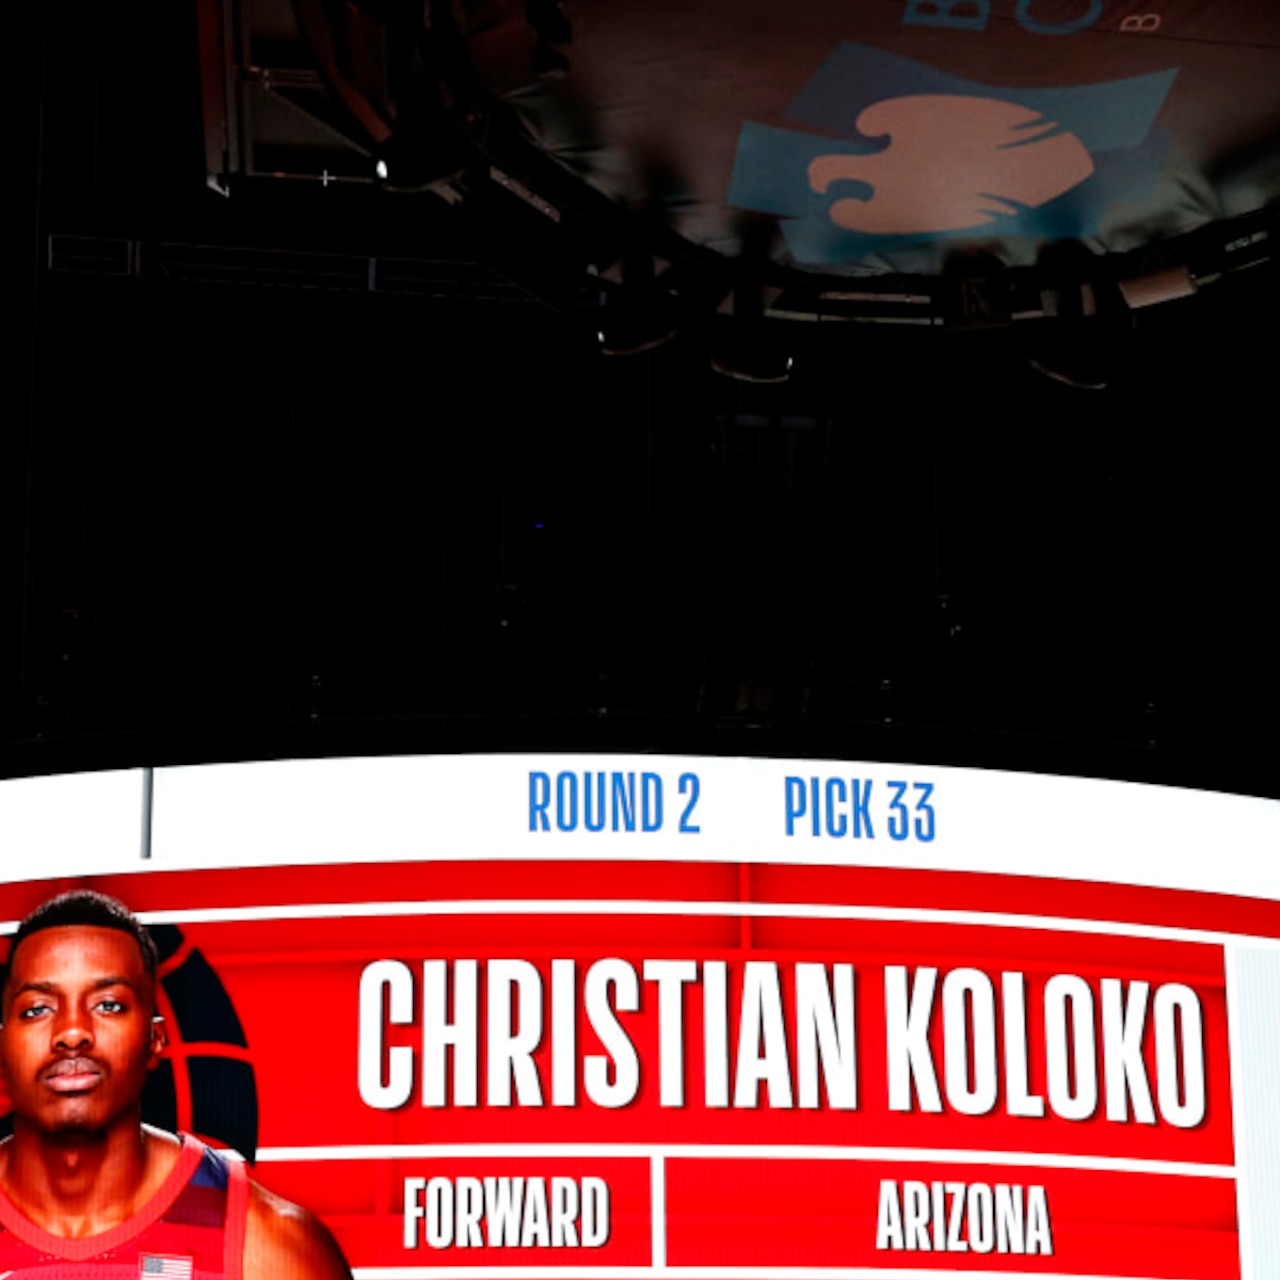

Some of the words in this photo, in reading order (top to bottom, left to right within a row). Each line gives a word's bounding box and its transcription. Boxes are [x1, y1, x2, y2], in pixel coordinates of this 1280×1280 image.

[528, 771, 663, 833] ROUND
[678, 772, 701, 834] 2
[784, 775, 875, 839] PICK
[886, 780, 937, 842] 33
[356, 957, 858, 1112] CHRISTIAN
[885, 965, 1208, 1129] KOLOKO
[403, 1177, 610, 1248] FORWARD
[876, 1180, 1053, 1255] ARIZONA
